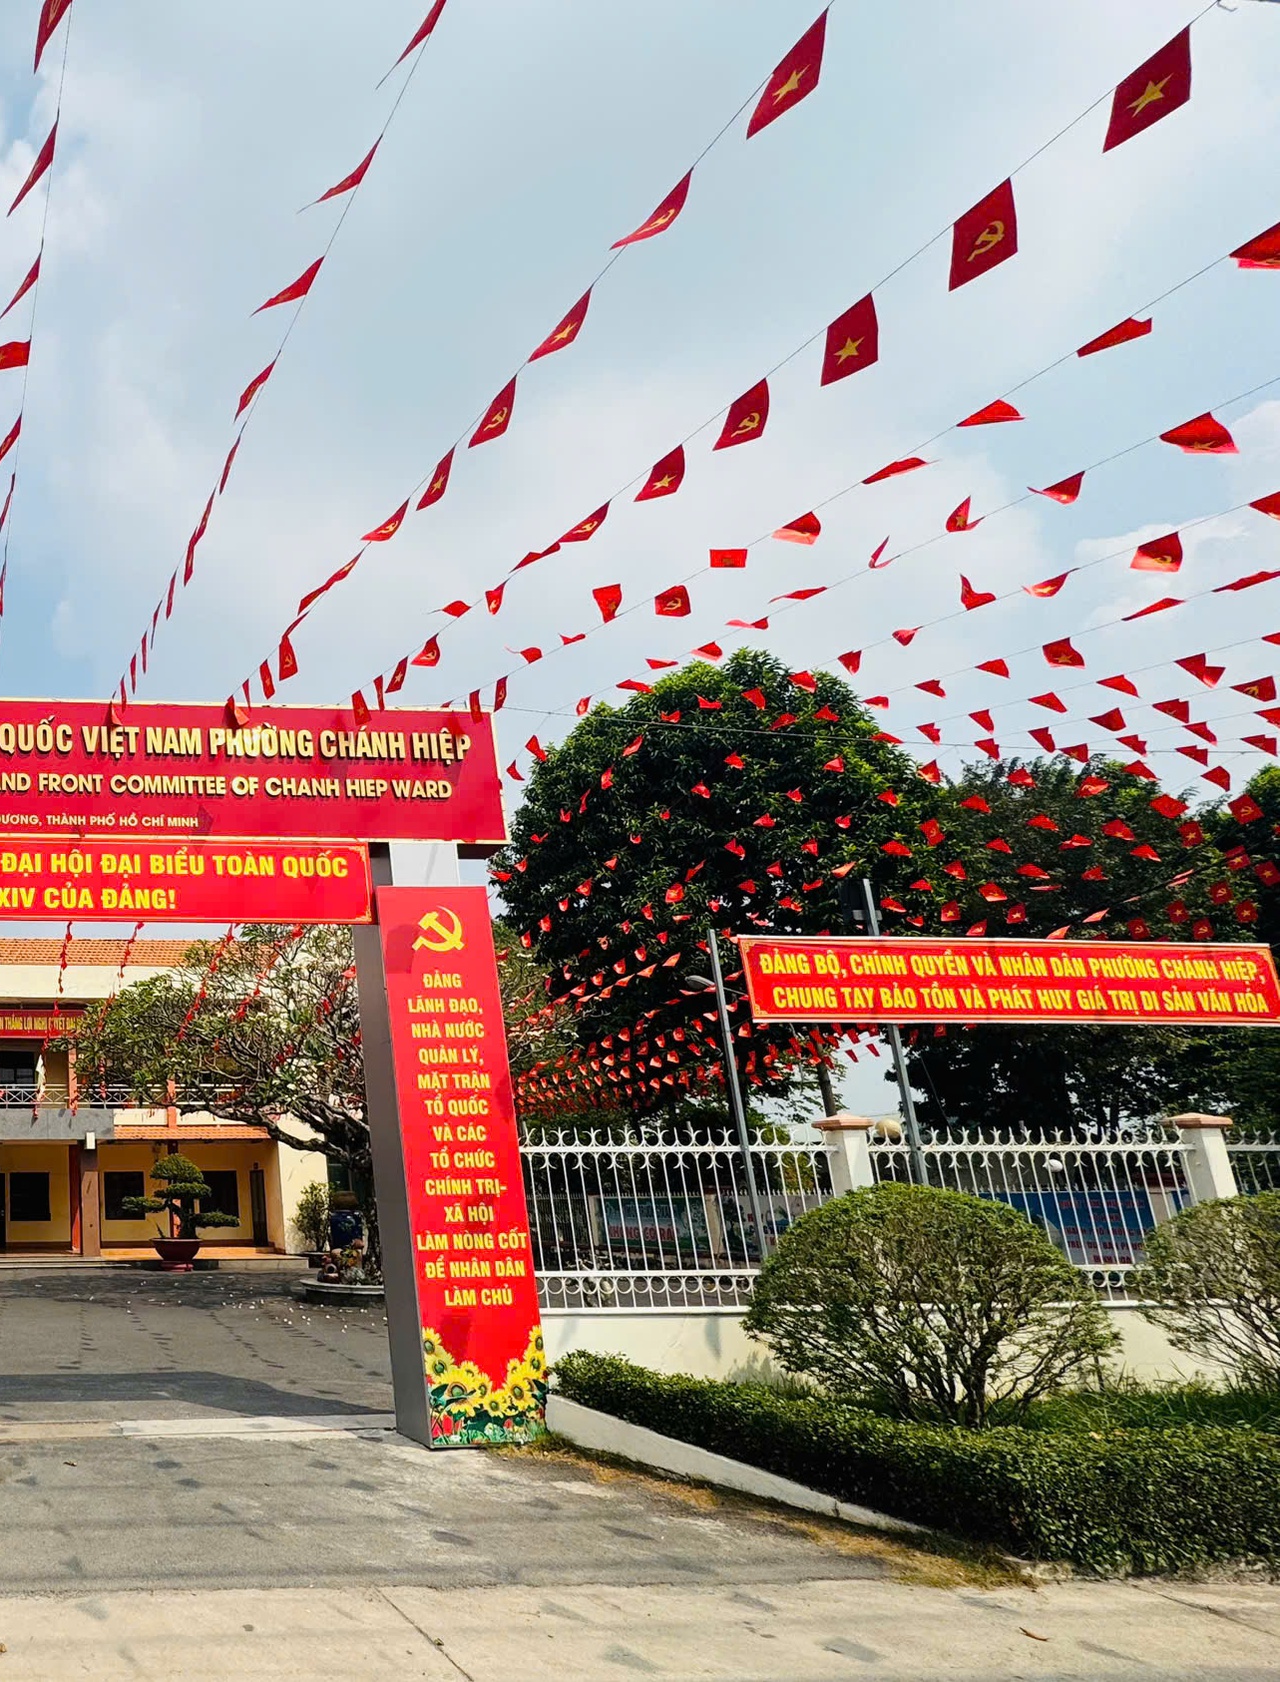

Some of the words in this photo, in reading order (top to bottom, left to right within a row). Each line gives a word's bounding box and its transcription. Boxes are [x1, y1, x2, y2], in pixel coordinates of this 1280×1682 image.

[82, 722, 140, 761] VIỆT
[146, 727, 201, 756] NAM
[209, 722, 313, 757] PHƯỜNG
[320, 725, 405, 759] CHÁNH
[412, 728, 470, 764] HIỆP
[39, 774, 104, 794] FRONT
[110, 775, 226, 796] COMMITTEE
[231, 777, 259, 796] OF
[265, 778, 340, 797] CHANH
[346, 779, 388, 798] HIEP
[392, 780, 452, 799] WARD
[46, 812, 86, 826] THÀNH
[90, 811, 116, 826] PHỐ
[119, 811, 138, 827] HỒ
[142, 813, 164, 827] CHÍ
[167, 817, 198, 828] MINH
[1, 853, 41, 878] ĐẠI
[51, 848, 91, 876] HỘI
[101, 855, 141, 879] ĐẠI
[151, 845, 203, 875] BIỂU
[212, 853, 274, 876] TOÀN
[283, 847, 348, 878] QUỐC
[45, 881, 92, 909] CỦA
[101, 881, 176, 910] ĐẢNG!
[760, 949, 810, 974] ĐẢNG
[814, 950, 847, 979] BỘ,
[849, 951, 907, 975] CHÍNH
[911, 950, 969, 977] QUYỀN
[972, 951, 997, 976] VÀ
[1000, 952, 1047, 976] NHÂN
[1052, 953, 1085, 977] DÂN
[1089, 955, 1159, 979] PHƯỜNG
[1162, 955, 1218, 980] CHÁNH
[1220, 957, 1265, 984] HIỆP,
[423, 970, 461, 988] ĐẢNG
[408, 995, 444, 1013] LÃNH
[449, 998, 483, 1015] ĐẠO,
[773, 987, 836, 1008] CHUNG
[841, 987, 874, 1008] TAY
[880, 983, 916, 1008] BẢO
[921, 982, 957, 1009] TỒN
[960, 984, 985, 1009] VÀ
[989, 985, 1033, 1009] PHÁT
[1037, 989, 1072, 1010] HUY
[1077, 985, 1107, 1010] GIÁ
[1108, 990, 1139, 1015] TRỊ
[1141, 990, 1159, 1011] DI
[1165, 986, 1195, 1012] SẢN
[1198, 988, 1232, 1012] VĂN
[1234, 988, 1269, 1013] HÓA
[412, 1020, 441, 1038] NHÀ
[445, 1020, 484, 1038] NƯỚC
[419, 1046, 458, 1064] QUẢN
[462, 1045, 484, 1066] LÝ,
[417, 1072, 448, 1091] MẶT
[452, 1072, 490, 1092] TRẬN
[425, 1094, 444, 1114] TỔ
[448, 1095, 488, 1115] QUỐC
[433, 1122, 453, 1141] VÀ
[457, 1121, 486, 1141] CÁC
[430, 1147, 448, 1168] TỔ
[454, 1148, 495, 1168] CHỨC
[425, 1175, 472, 1195] CHÍNH
[476, 1179, 507, 1197] TRỊ-
[444, 1203, 464, 1222] XÃ
[468, 1202, 494, 1223] HỘI
[417, 1231, 448, 1250] LÀM
[453, 1230, 493, 1250] NÒNG
[498, 1226, 527, 1249] CỐT
[425, 1254, 445, 1279] ĐỂ
[450, 1257, 491, 1277] NHÂN
[497, 1256, 525, 1277] DÂN
[444, 1285, 476, 1306] LÀM
[481, 1283, 512, 1305] CHỦ
